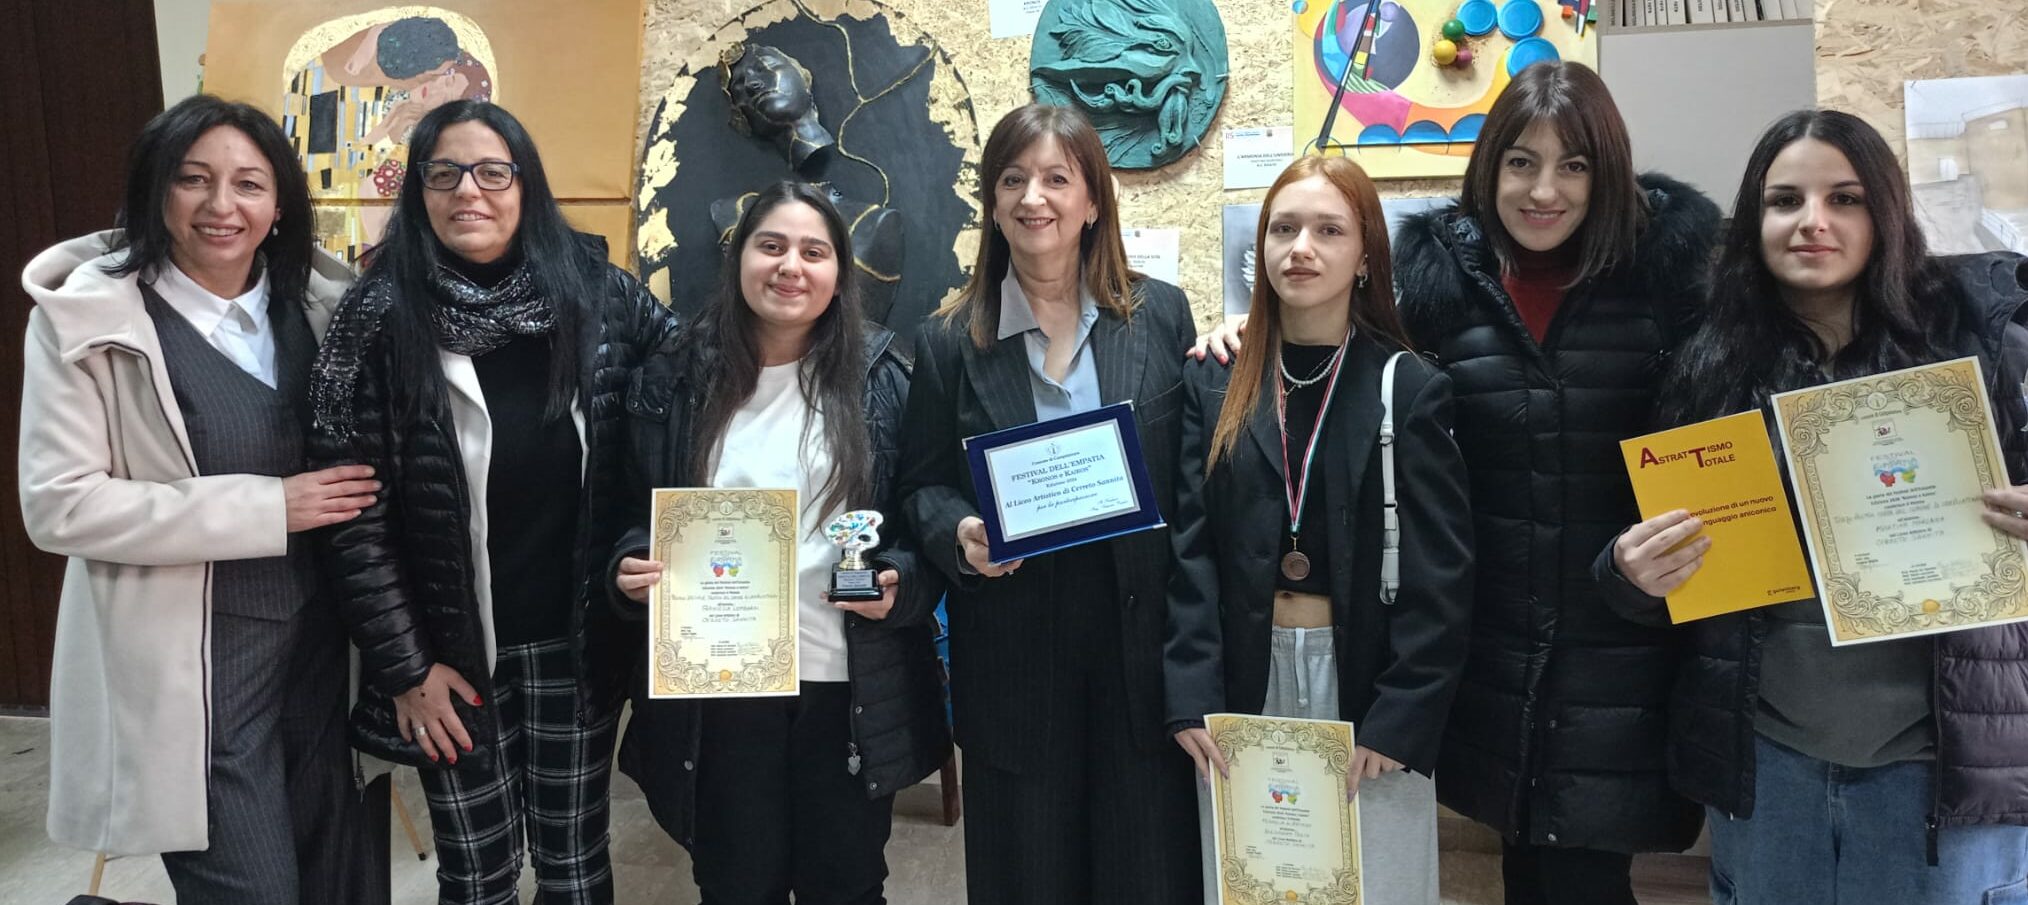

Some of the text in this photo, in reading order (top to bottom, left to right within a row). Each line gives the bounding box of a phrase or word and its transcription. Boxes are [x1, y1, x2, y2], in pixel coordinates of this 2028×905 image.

[1011, 467, 1048, 482] FESTIVAL
[1049, 454, 1105, 473] DELL'EMPATIA
[1005, 501, 1013, 509] Al
[1013, 497, 1032, 507] Liceo
[1062, 486, 1070, 494] di
[1071, 483, 1096, 493] Cerreto
[1097, 475, 1124, 486] Sannita
[1750, 495, 1774, 505] nuovo
[1703, 513, 1739, 526] nguaggio
